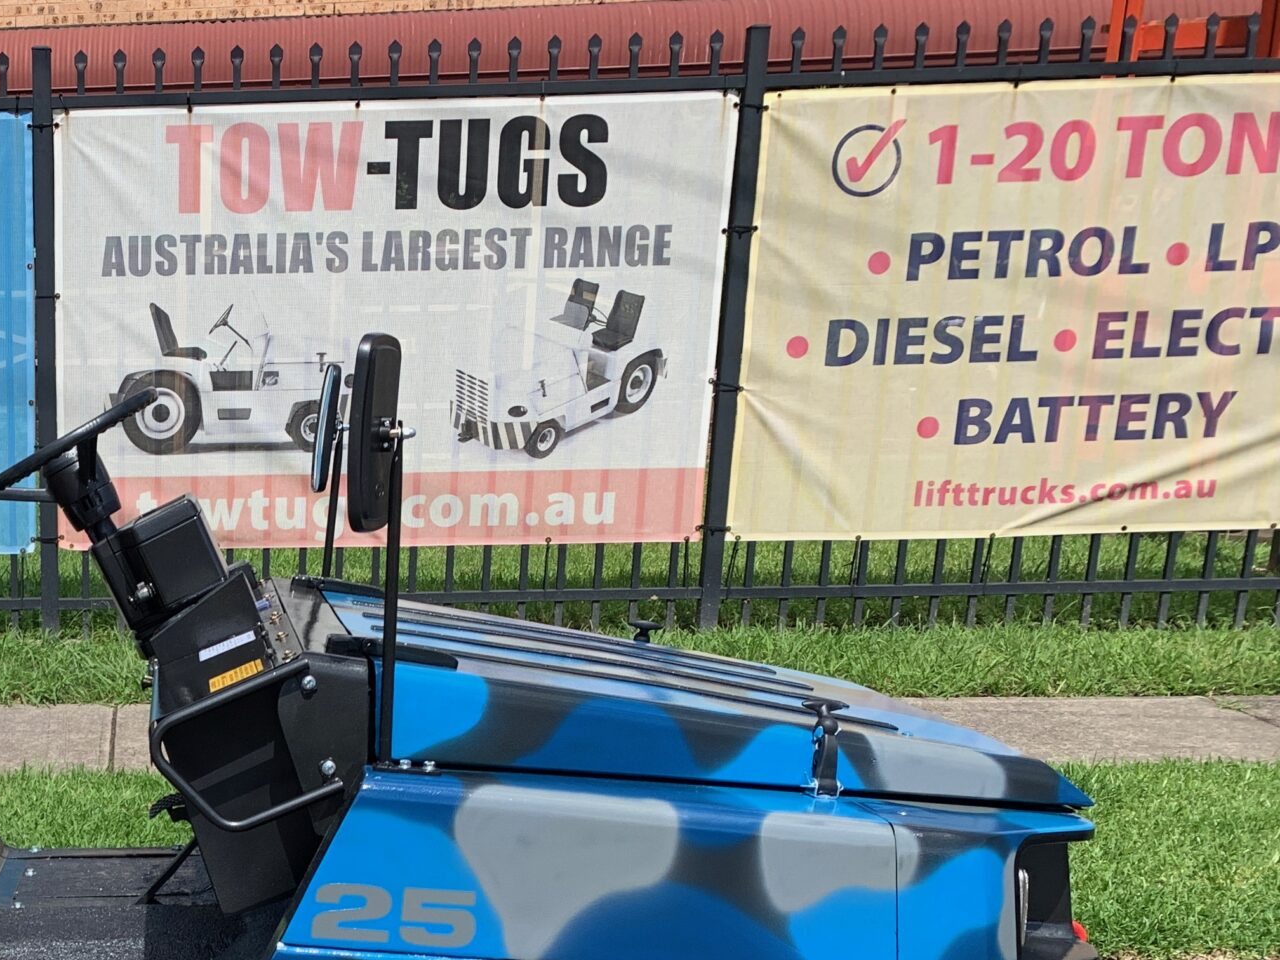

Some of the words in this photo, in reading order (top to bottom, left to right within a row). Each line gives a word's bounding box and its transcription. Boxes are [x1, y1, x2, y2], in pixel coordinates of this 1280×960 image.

[165, 114, 609, 214] TOW-TUGS
[928, 119, 1097, 185] 1-20
[1116, 111, 1280, 178] TON
[101, 230, 350, 278] AUSTRALIA'S
[361, 228, 533, 273] LARGEST
[543, 224, 673, 269] RANGE
[905, 225, 1150, 282] PETROL
[1204, 221, 1280, 272] LP
[824, 314, 1038, 367] DIESEL
[1091, 307, 1280, 361] ELECT
[953, 390, 1238, 446] BATTERY
[913, 477, 1217, 507] lifttrucks.com.au
[311, 882, 477, 948] 25
